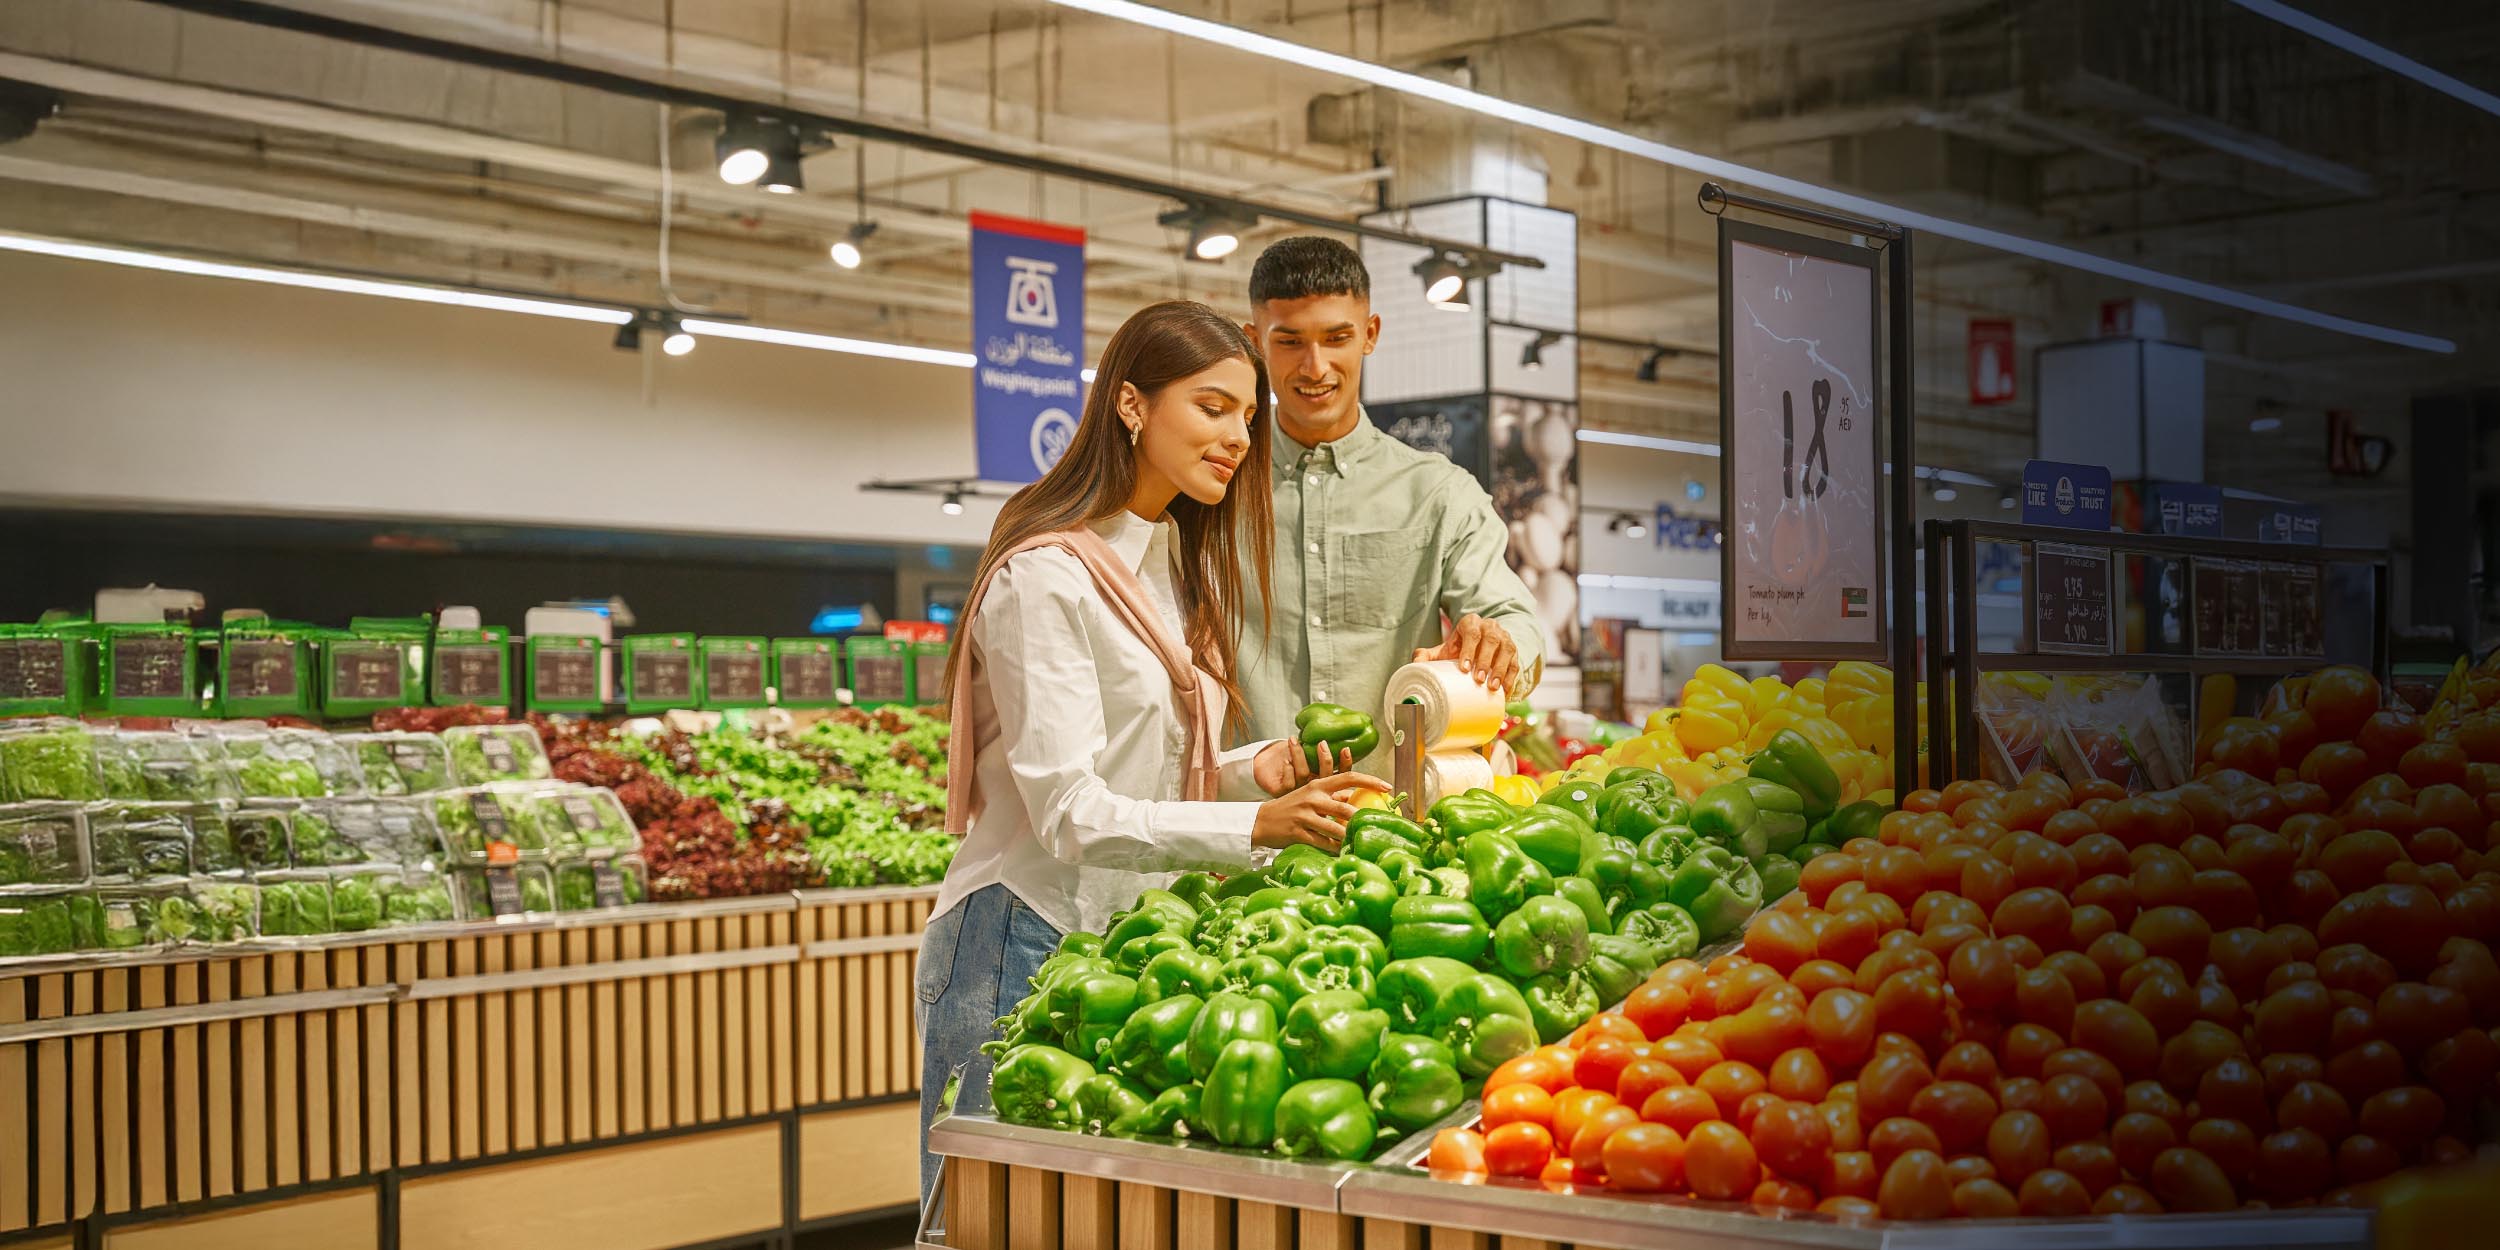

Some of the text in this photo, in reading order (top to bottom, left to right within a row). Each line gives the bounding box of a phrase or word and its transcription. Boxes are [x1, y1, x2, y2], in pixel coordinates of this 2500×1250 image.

[1838, 416, 1852, 431] AED
[1782, 378, 1832, 501] 18
[2027, 490, 2048, 507] LIKE
[2080, 496, 2104, 510] TRUST
[1748, 585, 1775, 600] Tomato
[1777, 587, 1795, 604] plum
[1747, 607, 1759, 621] Per
